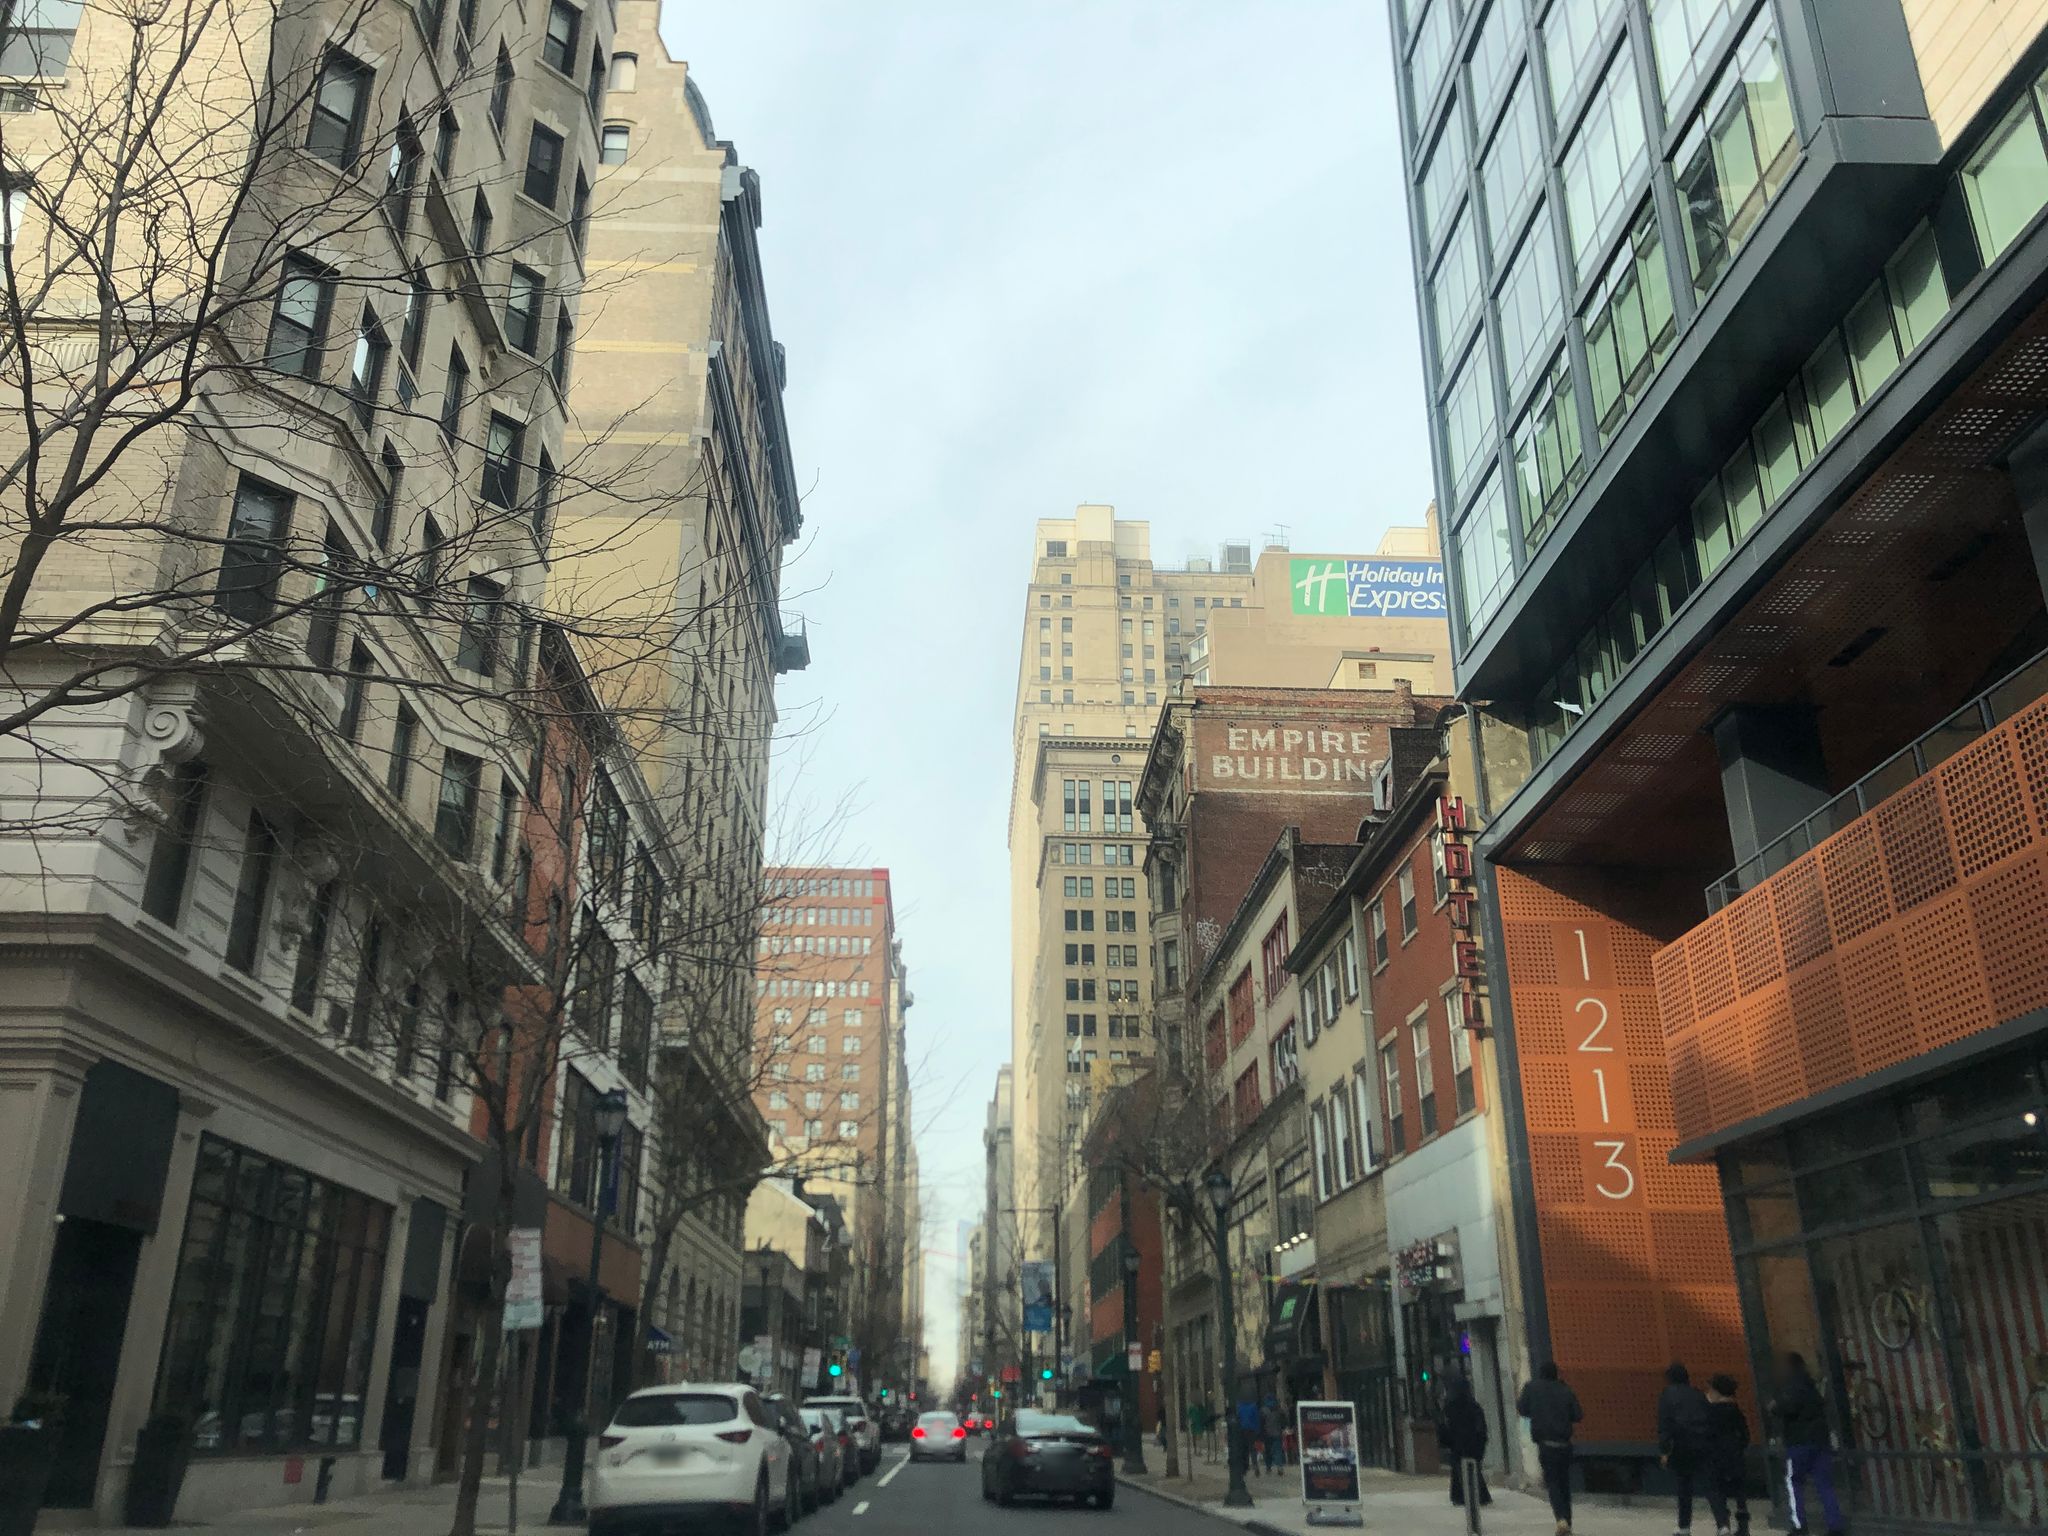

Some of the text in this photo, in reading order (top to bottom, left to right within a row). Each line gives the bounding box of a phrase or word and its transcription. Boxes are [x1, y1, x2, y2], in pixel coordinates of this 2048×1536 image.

[1348, 562, 1425, 587] Holiday
[1228, 727, 1372, 754] EMPIRE
[1435, 794, 1485, 1031] HOTEL
[1573, 928, 1635, 1200] 1213
